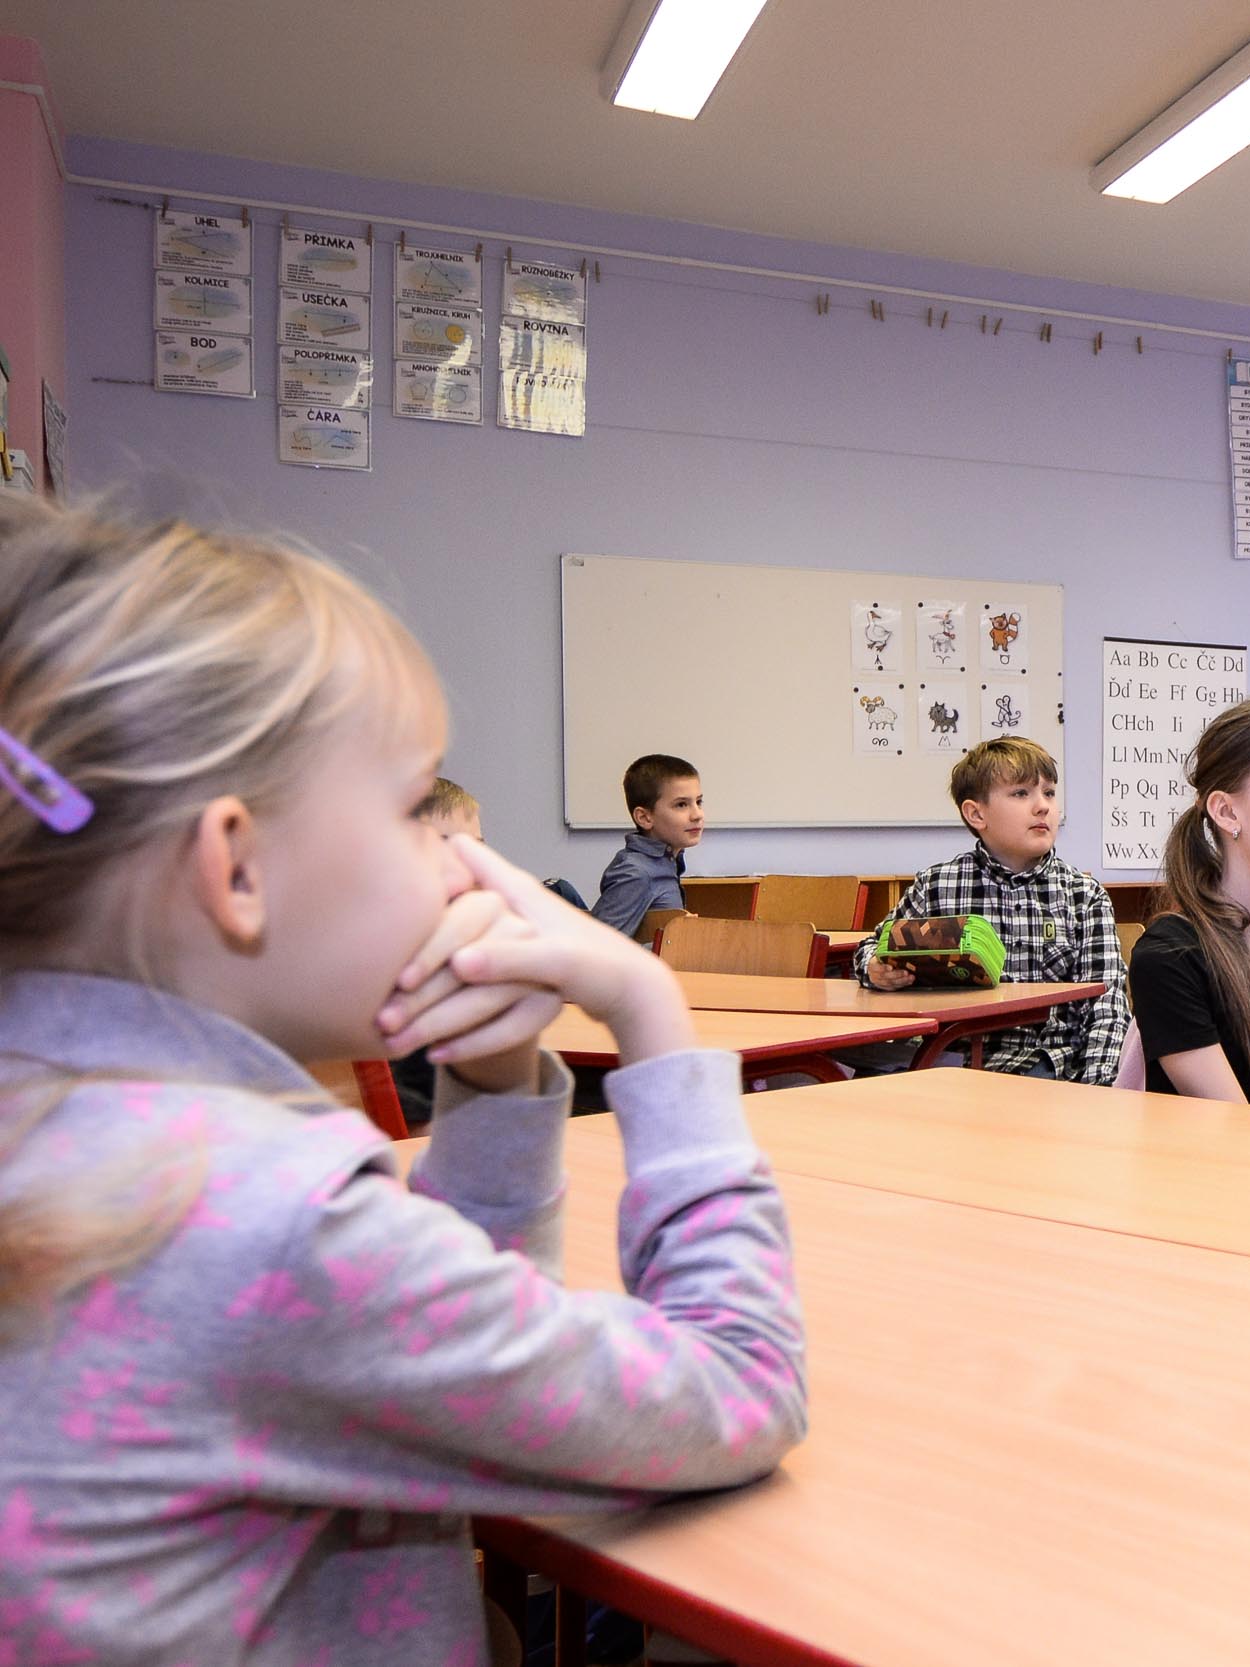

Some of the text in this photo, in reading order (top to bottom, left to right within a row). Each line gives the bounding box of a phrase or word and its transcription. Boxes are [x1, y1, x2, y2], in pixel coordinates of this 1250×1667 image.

[184, 275, 230, 288] KOLMICE
[452, 311, 471, 320] KRUH
[523, 320, 569, 336] ROVINA
[190, 336, 217, 349] BOD
[306, 408, 342, 424] ČÁRA
[1110, 649, 1244, 673] Aa Bb Cc Čč Dd
[1108, 676, 1244, 707] Ďď Ee Ff Gg Hh
[1111, 713, 1155, 732] CHch
[1172, 716, 1183, 732] Ii
[1133, 746, 1163, 764] Mm
[1110, 778, 1188, 800] Pp Qq Rr
[1111, 806, 1128, 828] Šš
[1139, 810, 1156, 828] Tt
[1105, 842, 1159, 860] Ww Xx
[1045, 923, 1053, 938] C
